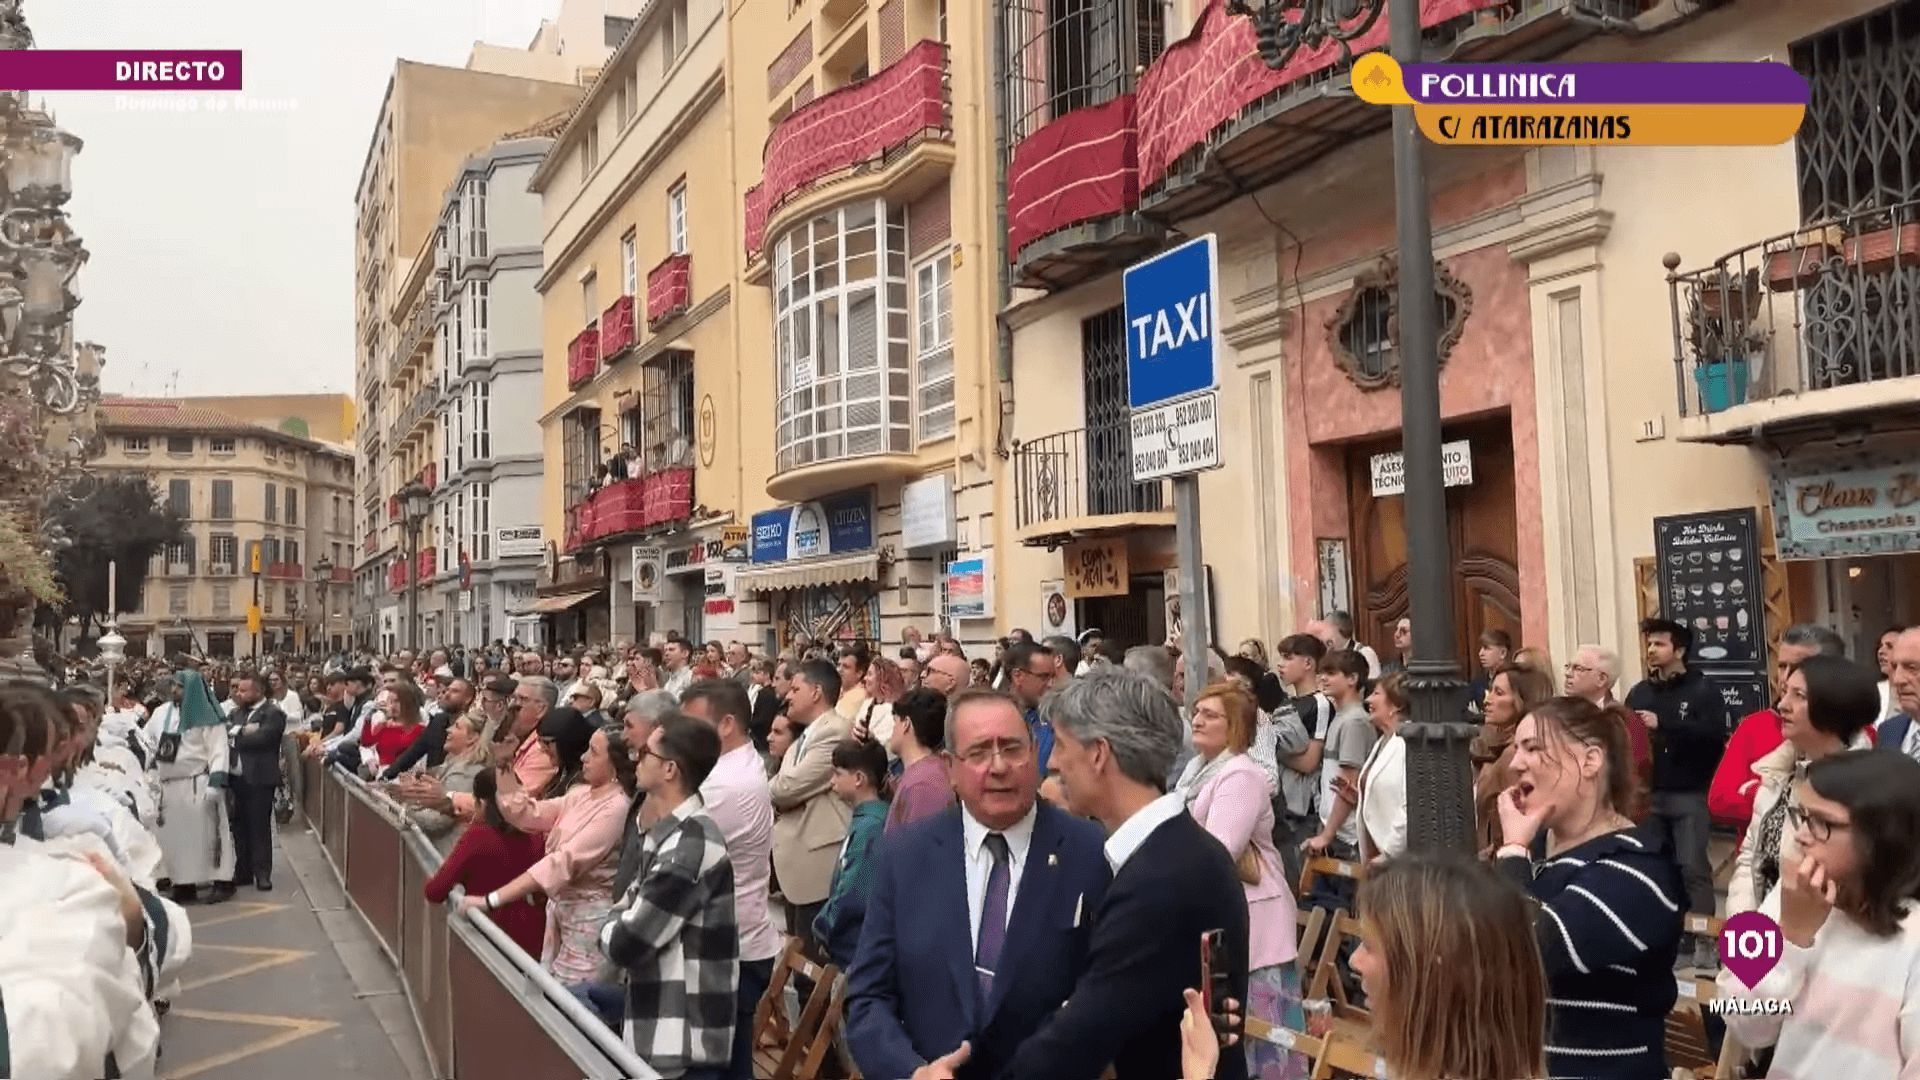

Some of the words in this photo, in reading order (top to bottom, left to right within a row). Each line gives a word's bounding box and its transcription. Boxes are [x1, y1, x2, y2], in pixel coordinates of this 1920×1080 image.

[1132, 292, 1208, 360] TAXI
[723, 531, 747, 541] ATM
[756, 522, 782, 540] SEIKO
